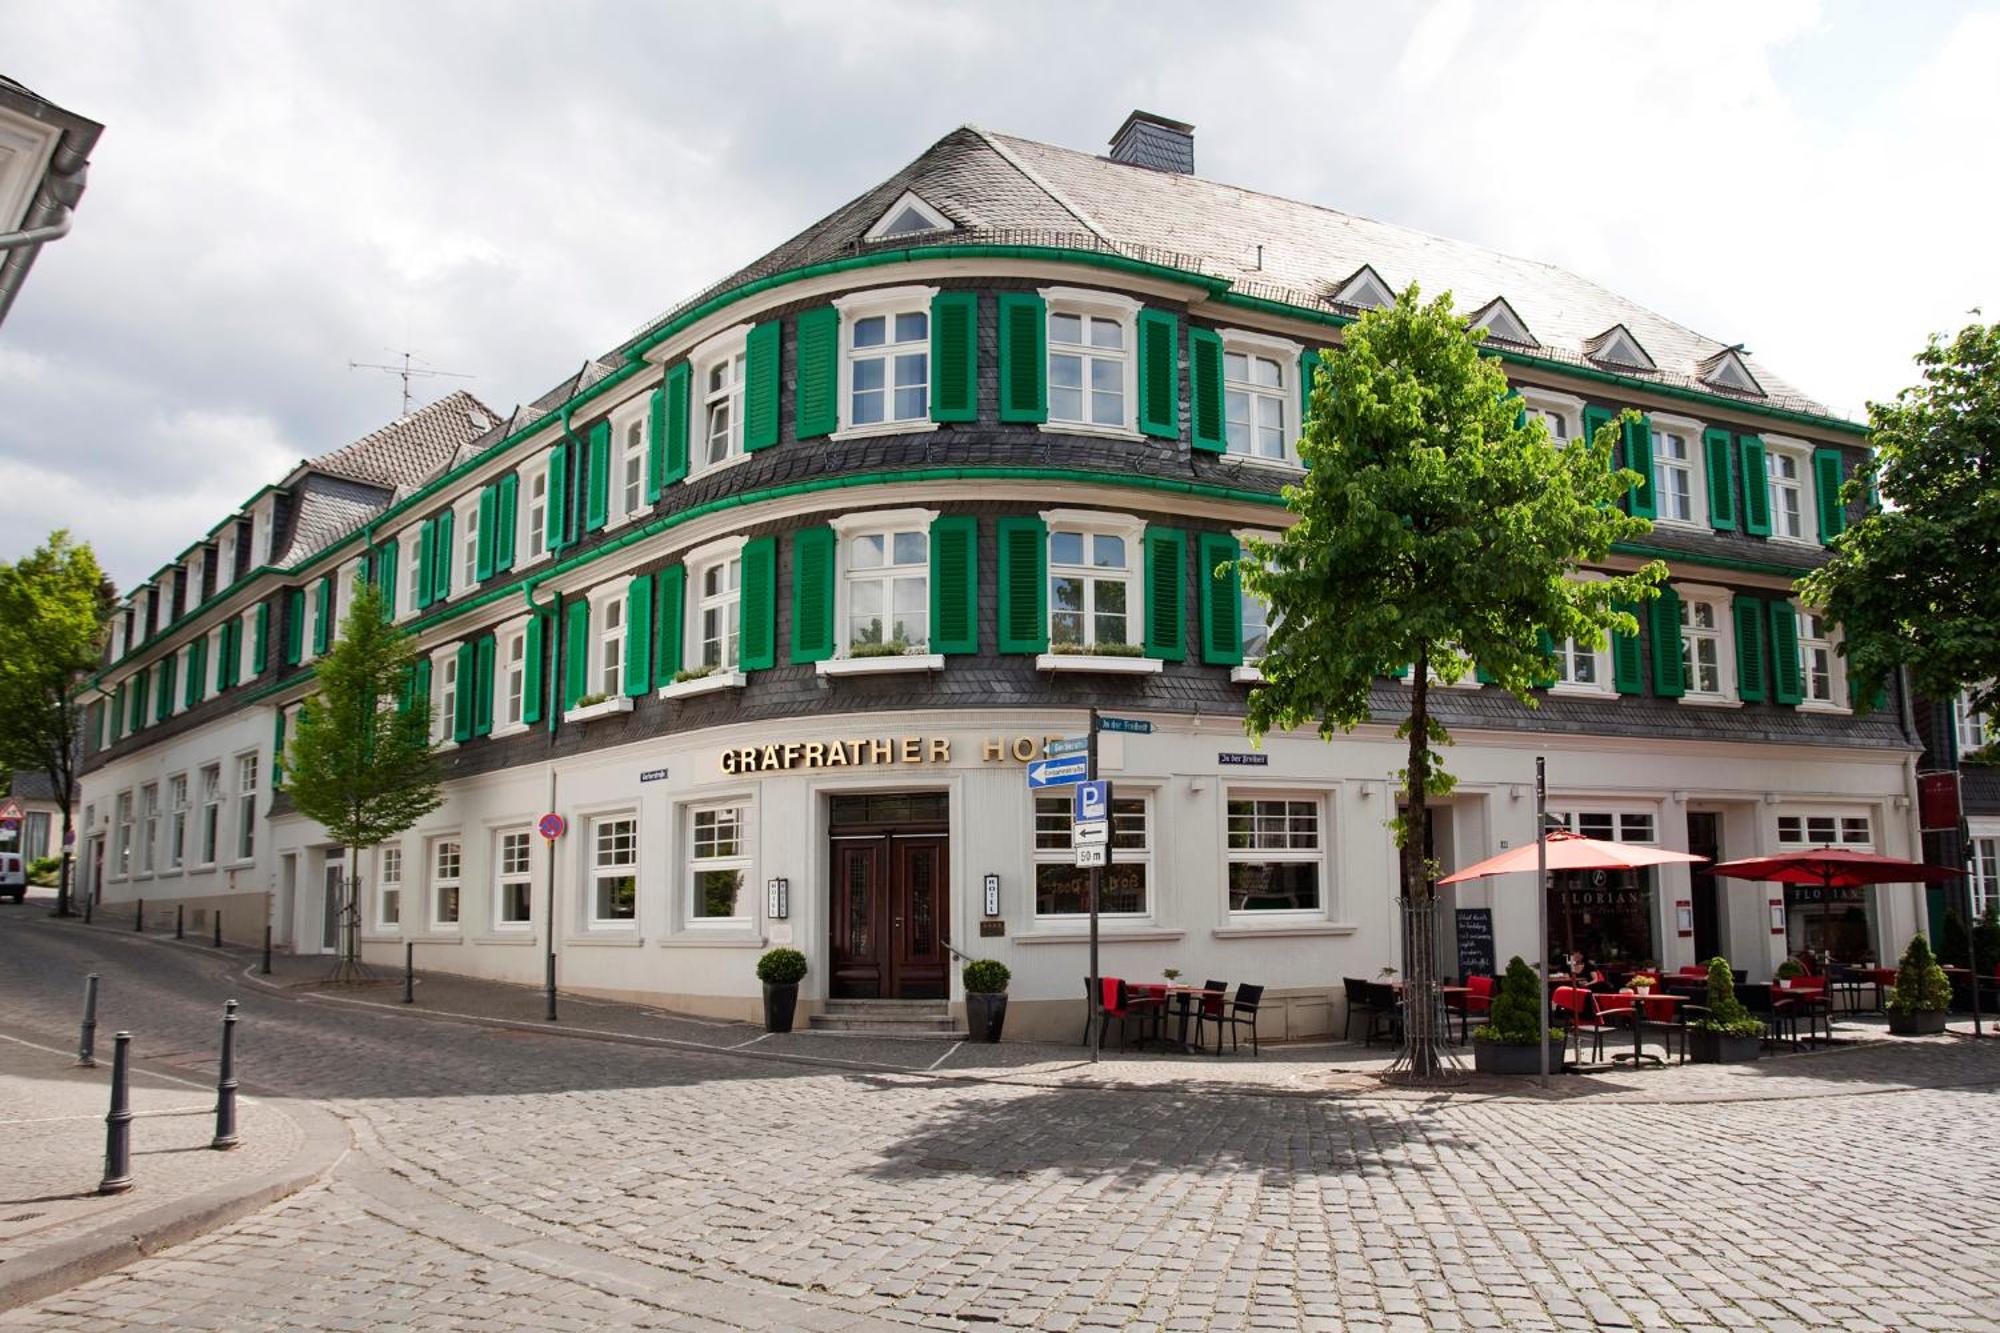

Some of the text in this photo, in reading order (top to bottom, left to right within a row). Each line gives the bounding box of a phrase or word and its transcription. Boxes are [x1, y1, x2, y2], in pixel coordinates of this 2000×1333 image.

[720, 735, 951, 774] GRÄFRATHER
[1083, 787, 1098, 817] P
[1080, 851, 1101, 862] 50 m
[1561, 892, 1639, 905] FLORIAN
[1794, 888, 1859, 900] FLOIAN
